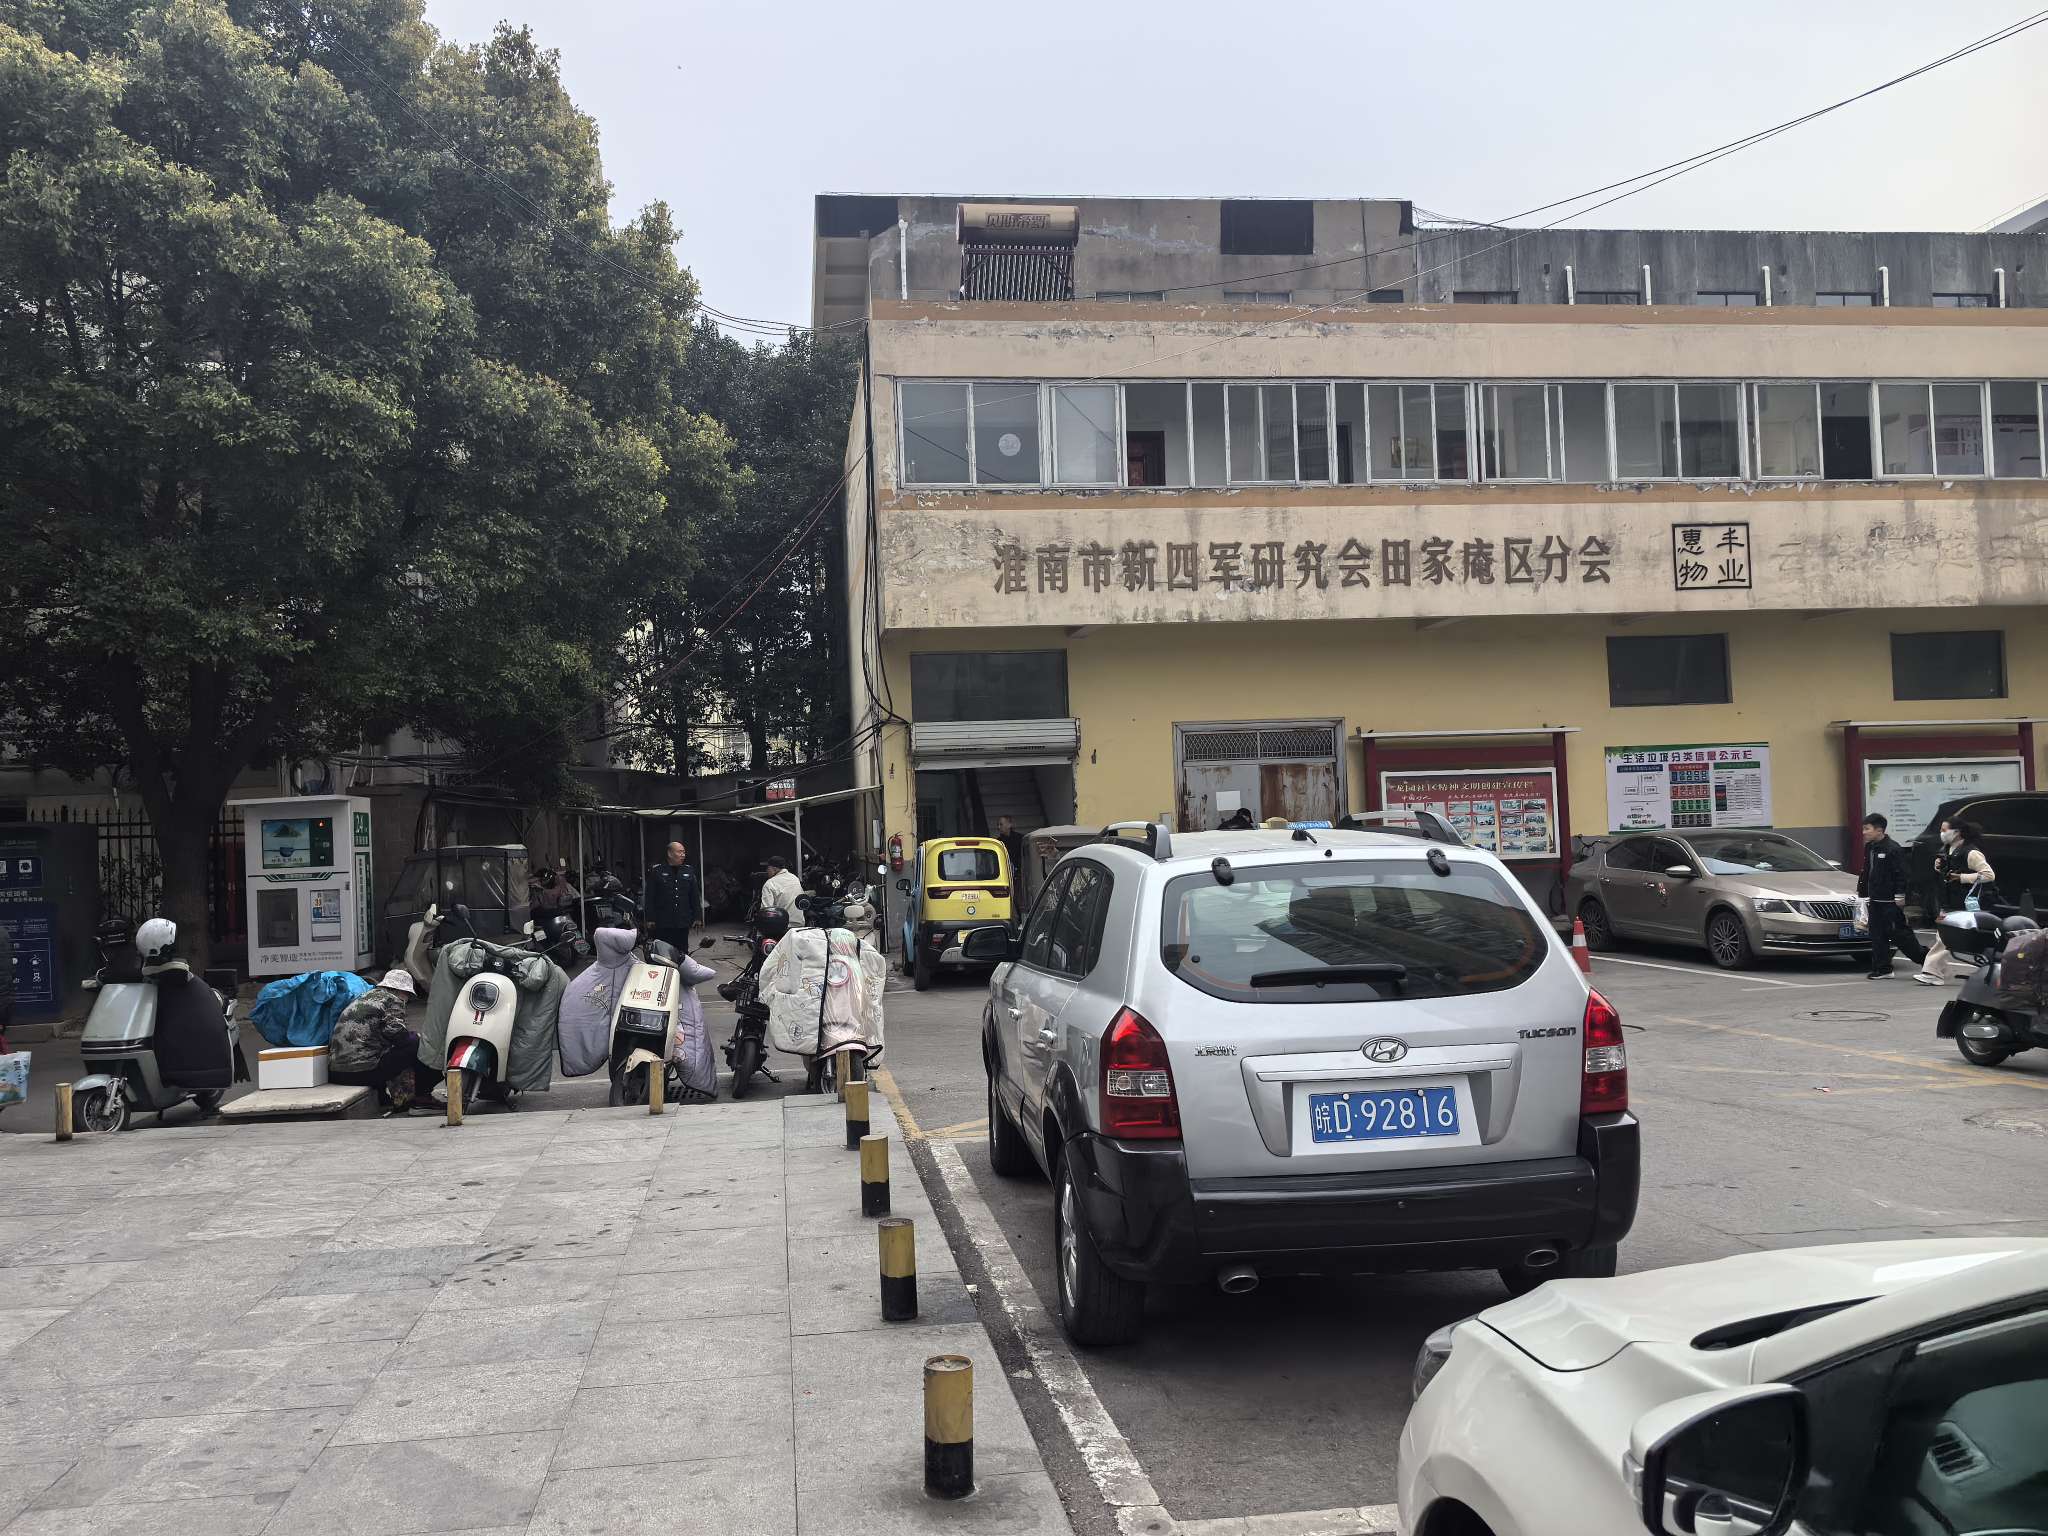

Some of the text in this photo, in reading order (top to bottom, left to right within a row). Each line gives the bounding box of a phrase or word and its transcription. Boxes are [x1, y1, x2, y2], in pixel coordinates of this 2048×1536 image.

[993, 535, 1612, 594] 淮南市新四军研究会田家庵区分会
[1623, 749, 1753, 764] 生活垃圾分类信息公示栏
